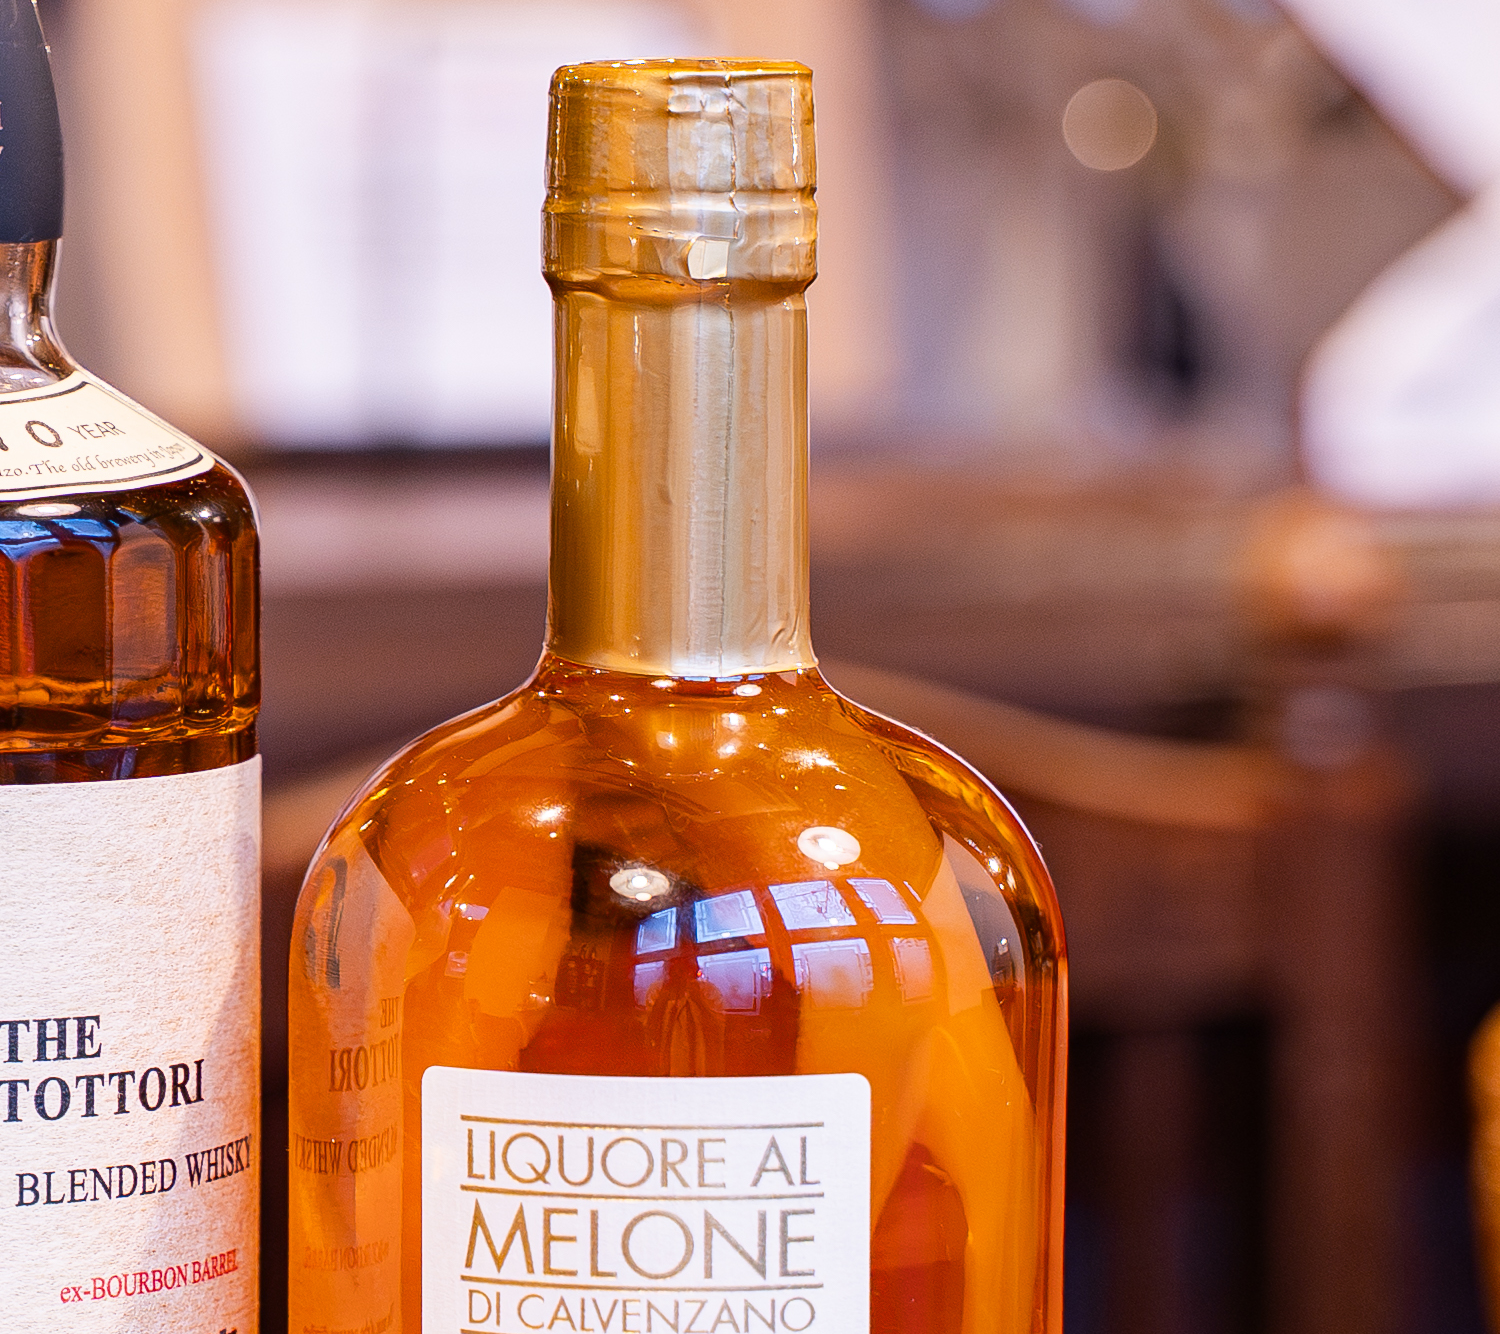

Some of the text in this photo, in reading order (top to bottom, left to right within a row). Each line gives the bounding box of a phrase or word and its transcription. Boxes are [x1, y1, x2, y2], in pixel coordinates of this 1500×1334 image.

[67, 421, 126, 441] YEAR
[72, 455, 97, 472] old
[95, 453, 156, 469] brewery
[15, 1133, 252, 1207] BLENDED WHISKY
[467, 1128, 821, 1189] LIQUORE AL
[464, 1197, 815, 1280] MELONE
[60, 1248, 239, 1304] ex-BOURBON BARREL
[468, 1289, 816, 1334] DI CALVENZANO
